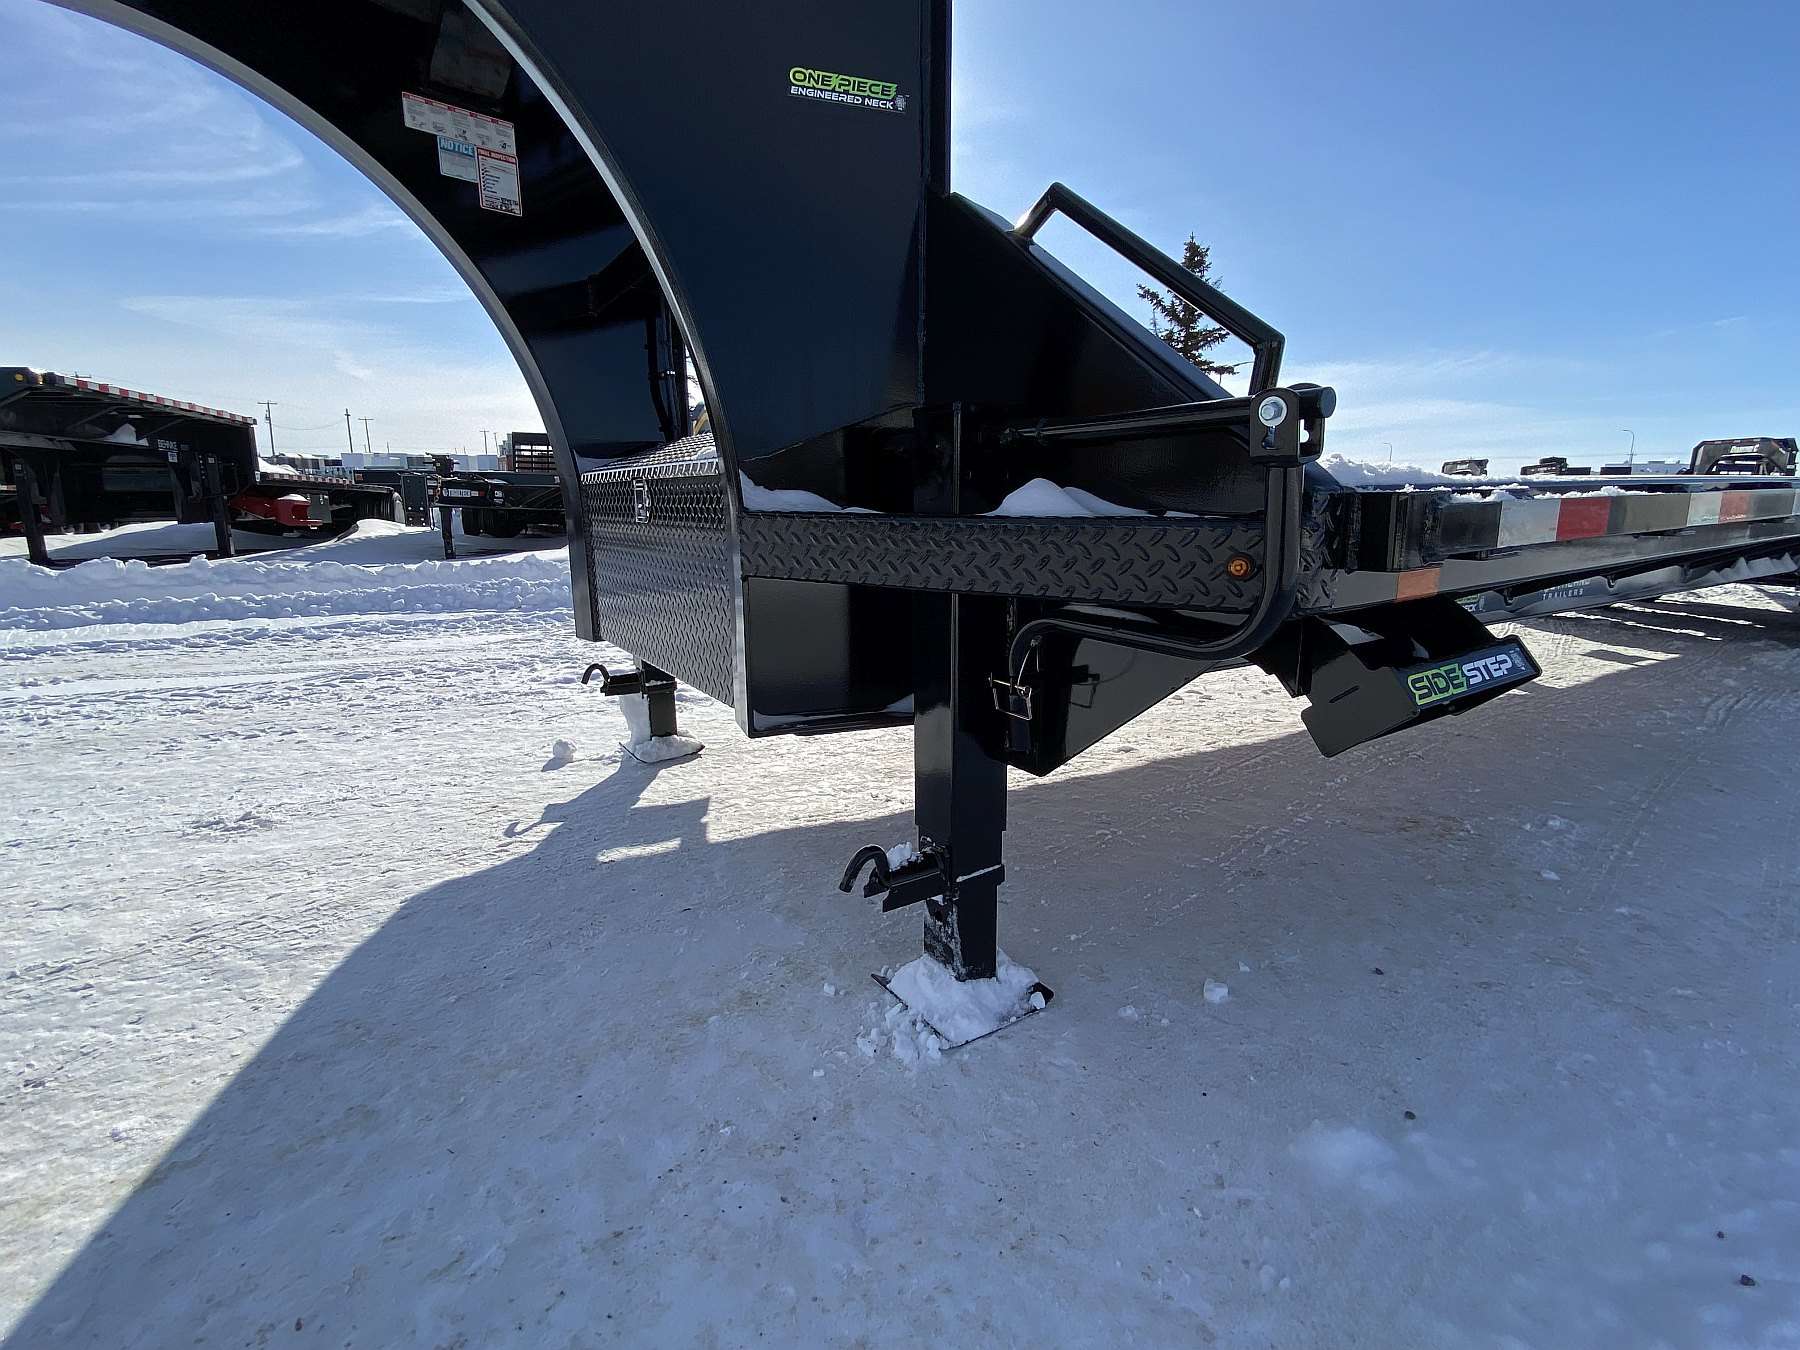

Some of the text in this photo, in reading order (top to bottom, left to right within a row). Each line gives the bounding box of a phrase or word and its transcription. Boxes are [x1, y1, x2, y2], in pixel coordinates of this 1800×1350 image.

[791, 68, 896, 98] ONE PIECE
[790, 85, 894, 110] ENGINEERED NECK
[440, 137, 475, 157] NOTICE
[1542, 588, 1584, 601] TRAILERS
[1409, 654, 1513, 703] SIDE STEP
